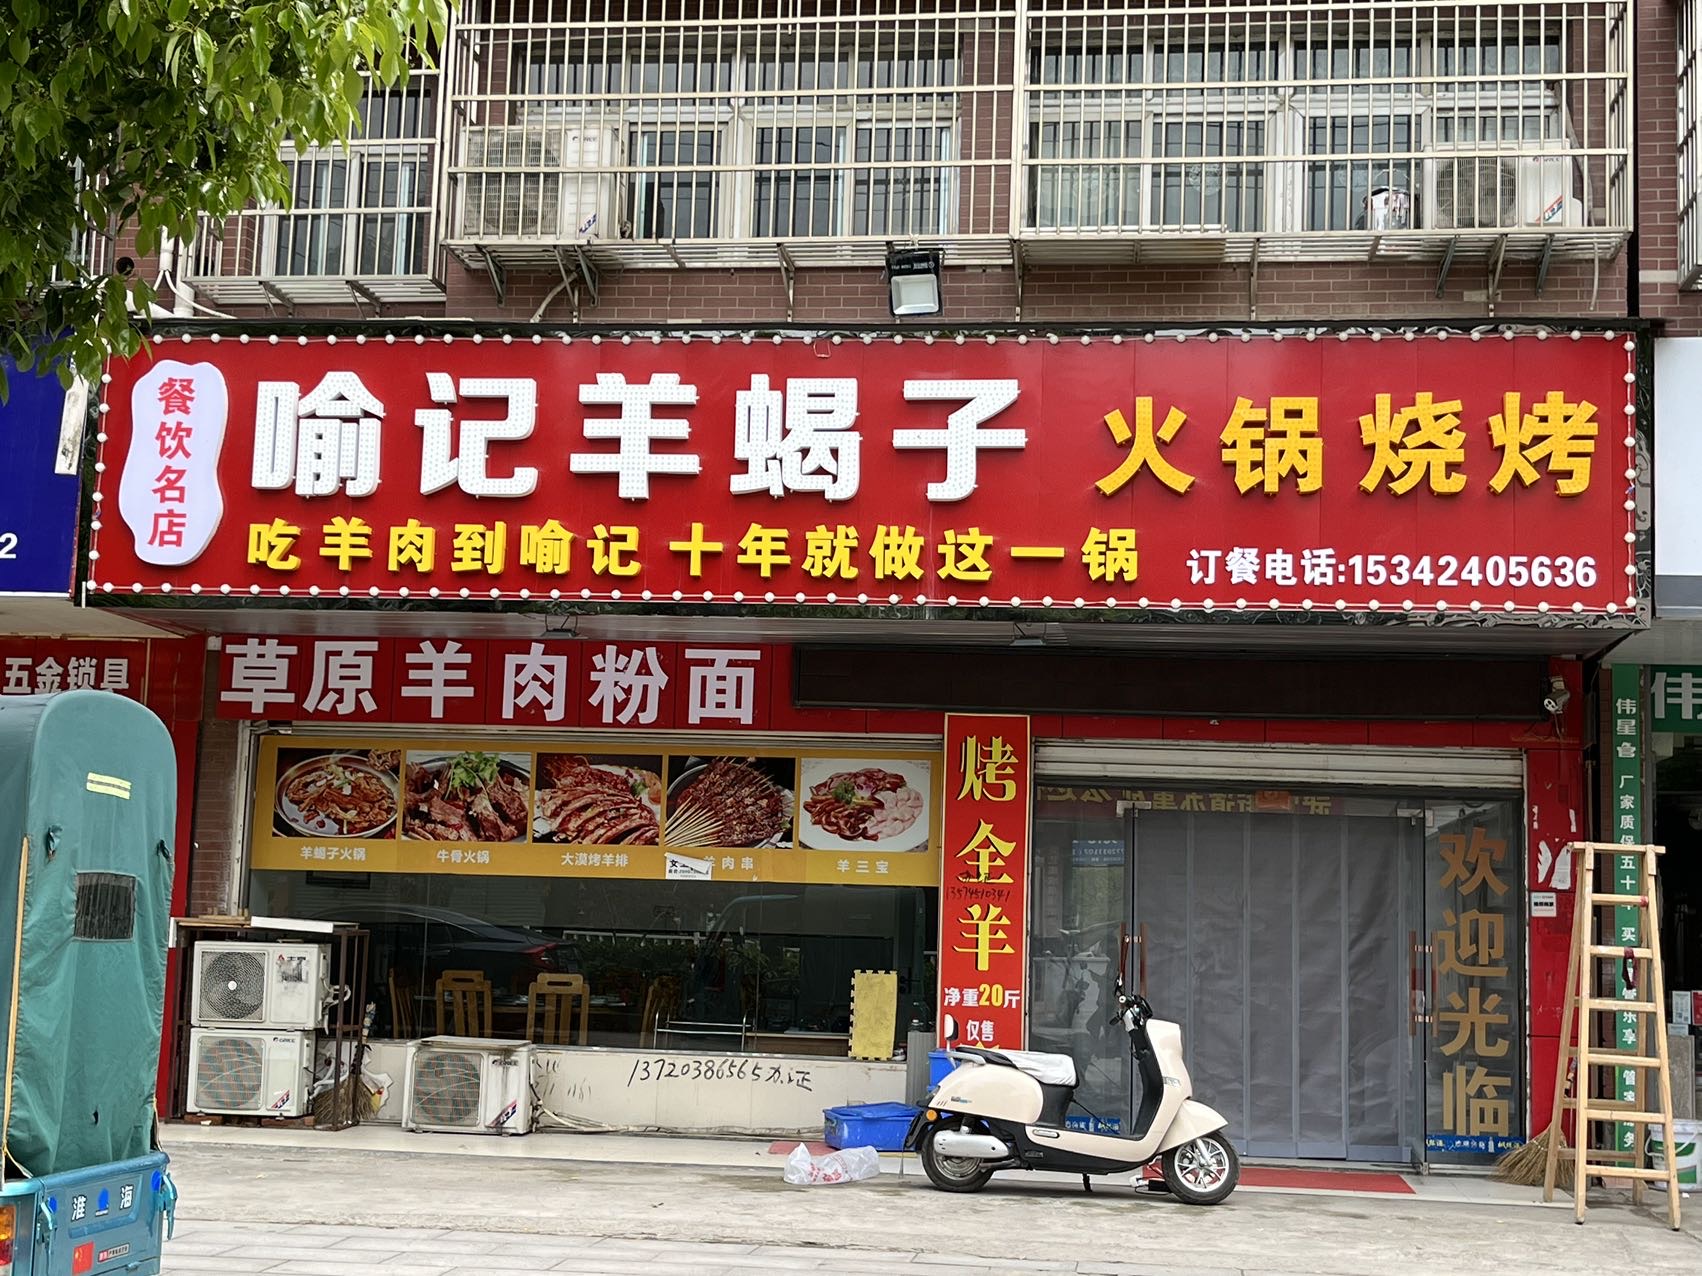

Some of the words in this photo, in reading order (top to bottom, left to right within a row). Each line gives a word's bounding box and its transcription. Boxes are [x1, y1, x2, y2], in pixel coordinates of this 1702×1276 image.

[251, 371, 1027, 501] 喻记羊蝎子
[1095, 391, 1599, 496] 火锅烧烤
[148, 377, 196, 548] 餐饮名店
[247, 516, 642, 577] 吃羊肉到喻记
[669, 522, 1140, 583] 十年就做这一锅
[1186, 548, 1597, 588] 订餐电话:15342405636
[3, 657, 129, 694] 五金锁具
[220, 638, 762, 725] 草原羊肉粉面
[300, 846, 366, 861] 羊蝎子火锅
[437, 849, 490, 864] 牛骨火锅
[561, 853, 628, 868] 大漠烤羊排
[837, 859, 889, 874] 羊三宝
[952, 735, 1018, 972] 烤全羊
[943, 983, 1021, 1009] 净重20斤
[1437, 827, 1511, 1137] 欢迎光临
[966, 1019, 995, 1042] 仅售
[119, 1184, 135, 1210] 海
